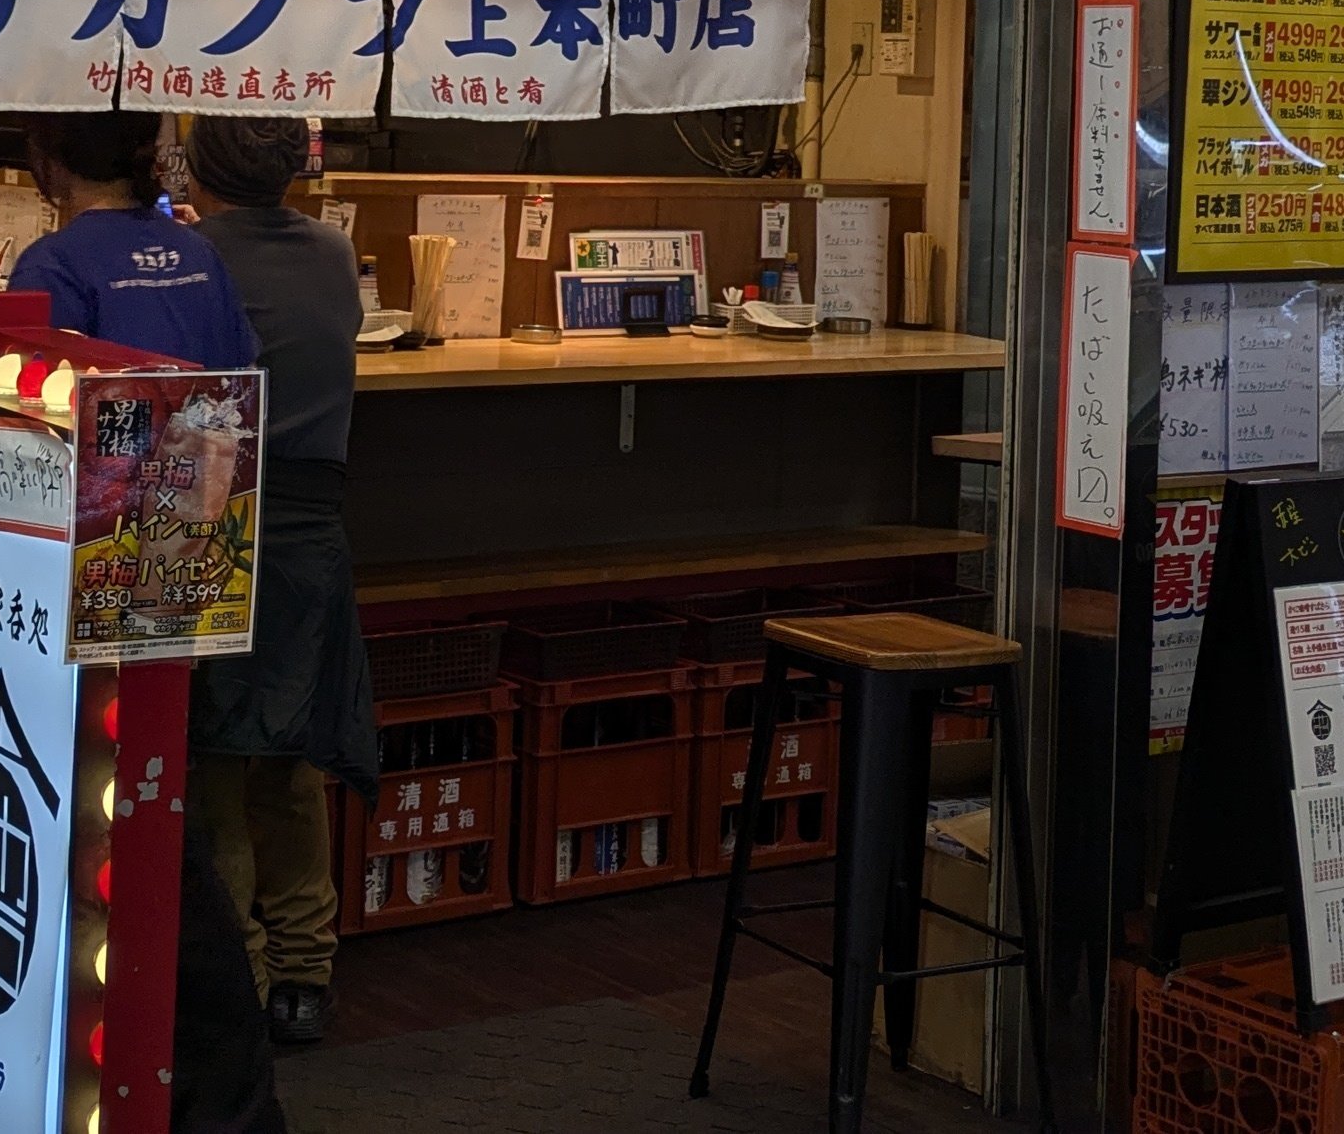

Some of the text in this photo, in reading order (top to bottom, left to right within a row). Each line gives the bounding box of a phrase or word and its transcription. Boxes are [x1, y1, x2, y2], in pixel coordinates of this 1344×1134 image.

[1205, 21, 1253, 47] サワー
[1276, 22, 1326, 47] 499円
[86, 59, 336, 104] 竹内酒造直売所
[429, 74, 547, 108] 清酒と肴
[1274, 79, 1324, 105] 499円
[1195, 193, 1242, 219] 日本酒
[1246, 197, 1256, 231] グラス
[96, 414, 112, 457] サワー
[112, 400, 138, 457] 男梅
[138, 456, 196, 492] 男梅
[83, 554, 229, 589] 男梅パイセン
[81, 589, 132, 610] ¥350
[172, 584, 222, 605] ¥599
[731, 763, 813, 791] 専通箱
[396, 777, 462, 812] 清酒
[378, 808, 476, 842] 専用通箱
